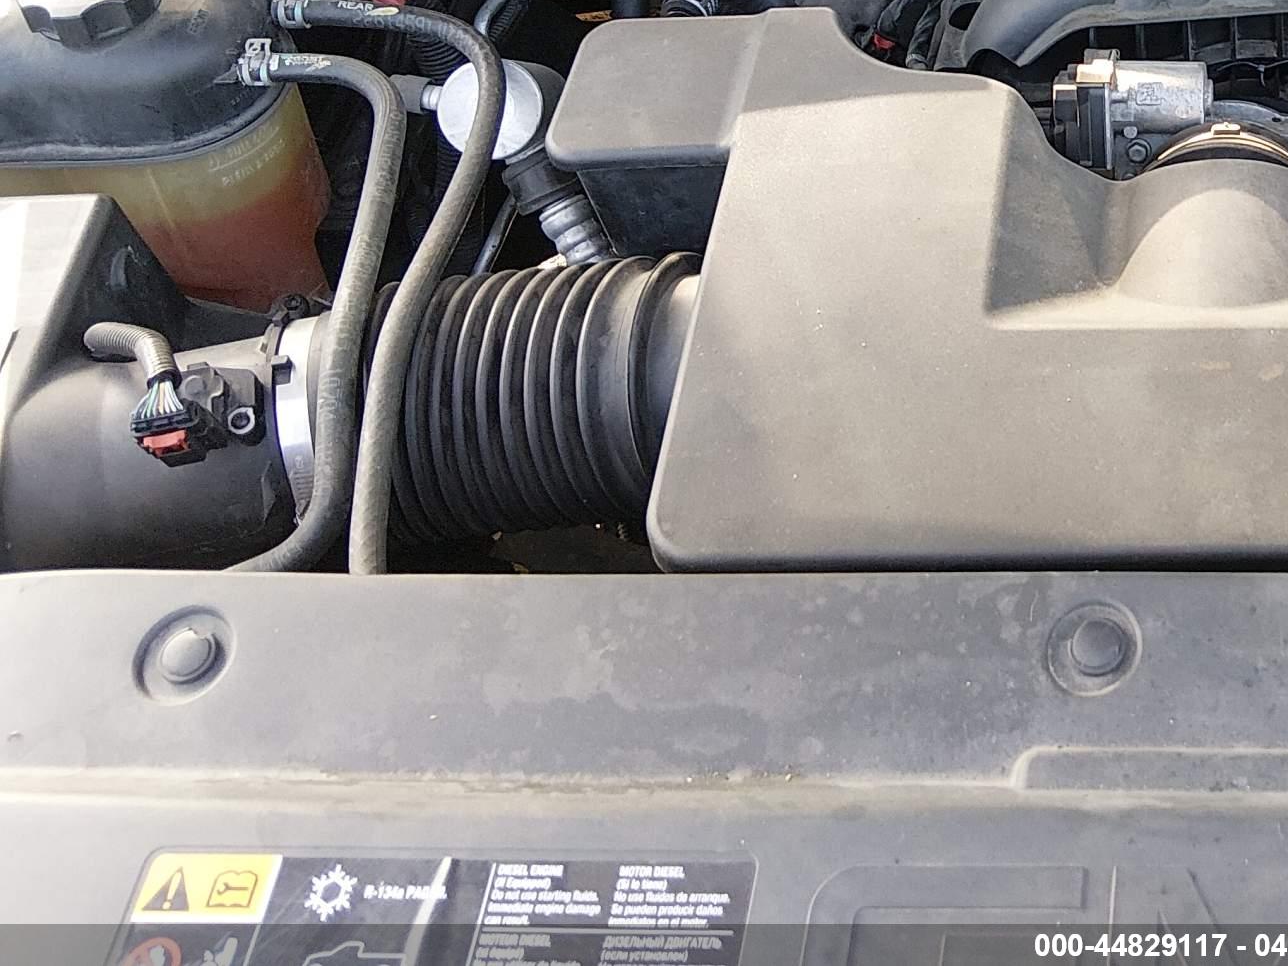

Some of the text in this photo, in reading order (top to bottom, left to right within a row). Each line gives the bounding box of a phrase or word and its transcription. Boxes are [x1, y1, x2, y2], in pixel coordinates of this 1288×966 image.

[337, 0, 373, 12] REAR
[620, 866, 684, 878] MOTOR DIESEL
[492, 889, 503, 900] Do
[505, 890, 520, 900] not
[521, 892, 537, 900] use
[538, 891, 571, 903] starting
[614, 891, 626, 901] No
[628, 893, 643, 902] use
[676, 893, 687, 902] de
[689, 894, 729, 904] arranque.
[535, 904, 564, 915] engine
[566, 904, 601, 916] damage
[611, 904, 723, 916] Se pueden producir daños
